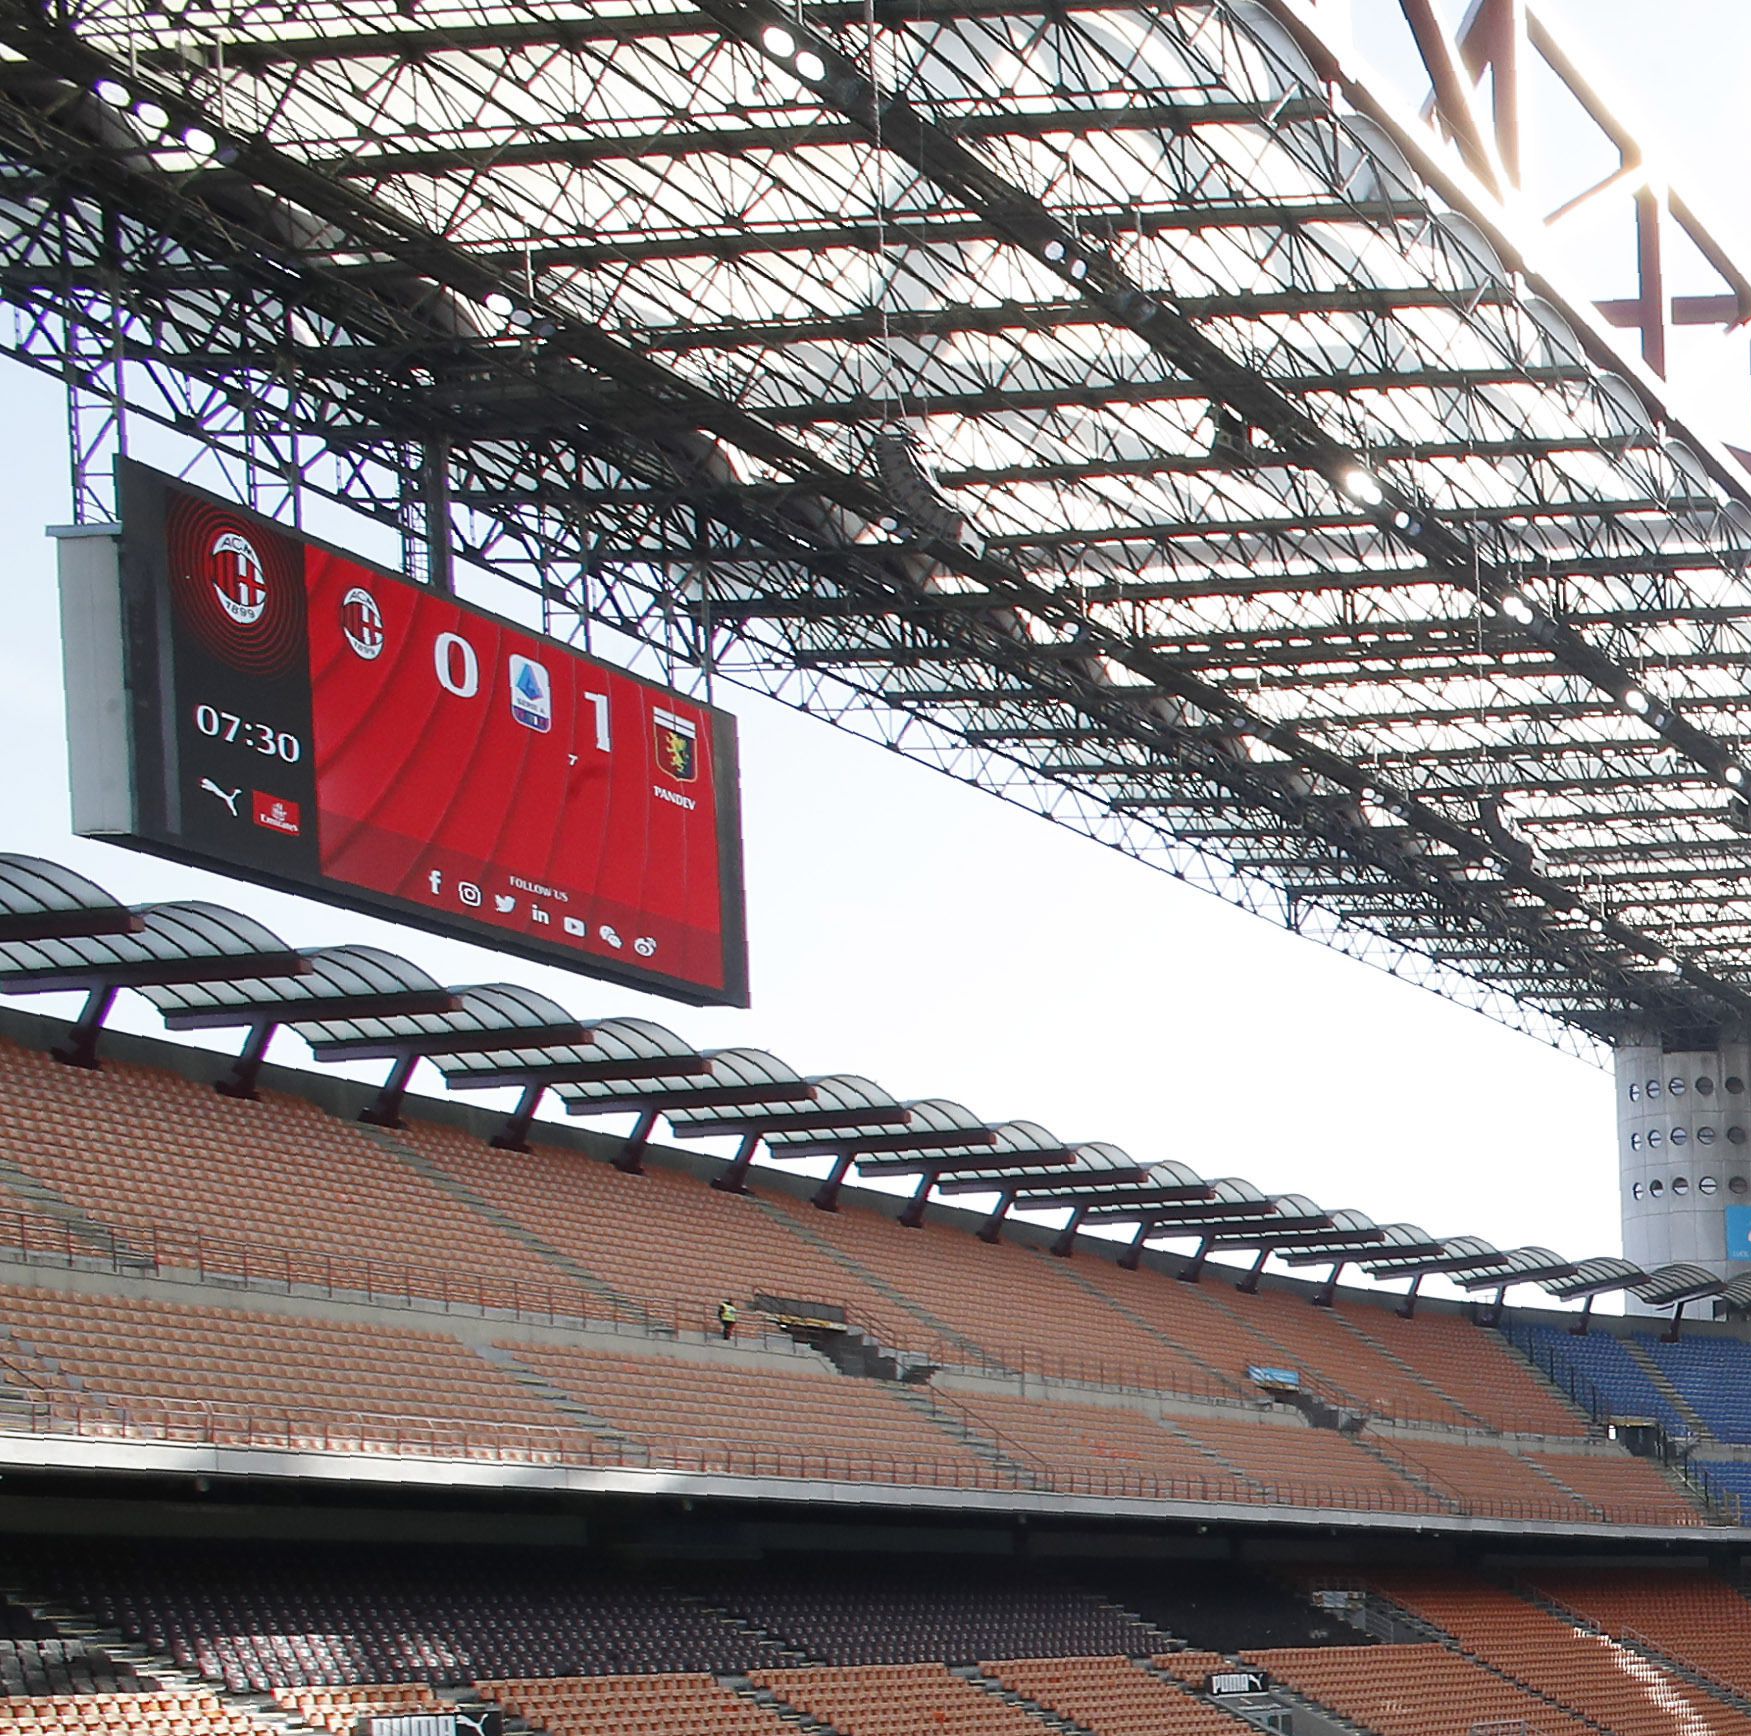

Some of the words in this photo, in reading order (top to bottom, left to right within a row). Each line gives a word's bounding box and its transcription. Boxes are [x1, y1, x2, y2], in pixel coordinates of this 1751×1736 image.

[225, 599, 256, 619] 1899
[434, 631, 479, 698] 0
[196, 704, 300, 763] 07:30
[584, 690, 611, 752] 1
[653, 785, 696, 811] PANDEV
[509, 875, 551, 897] FOLLOW
[553, 888, 568, 903] US
